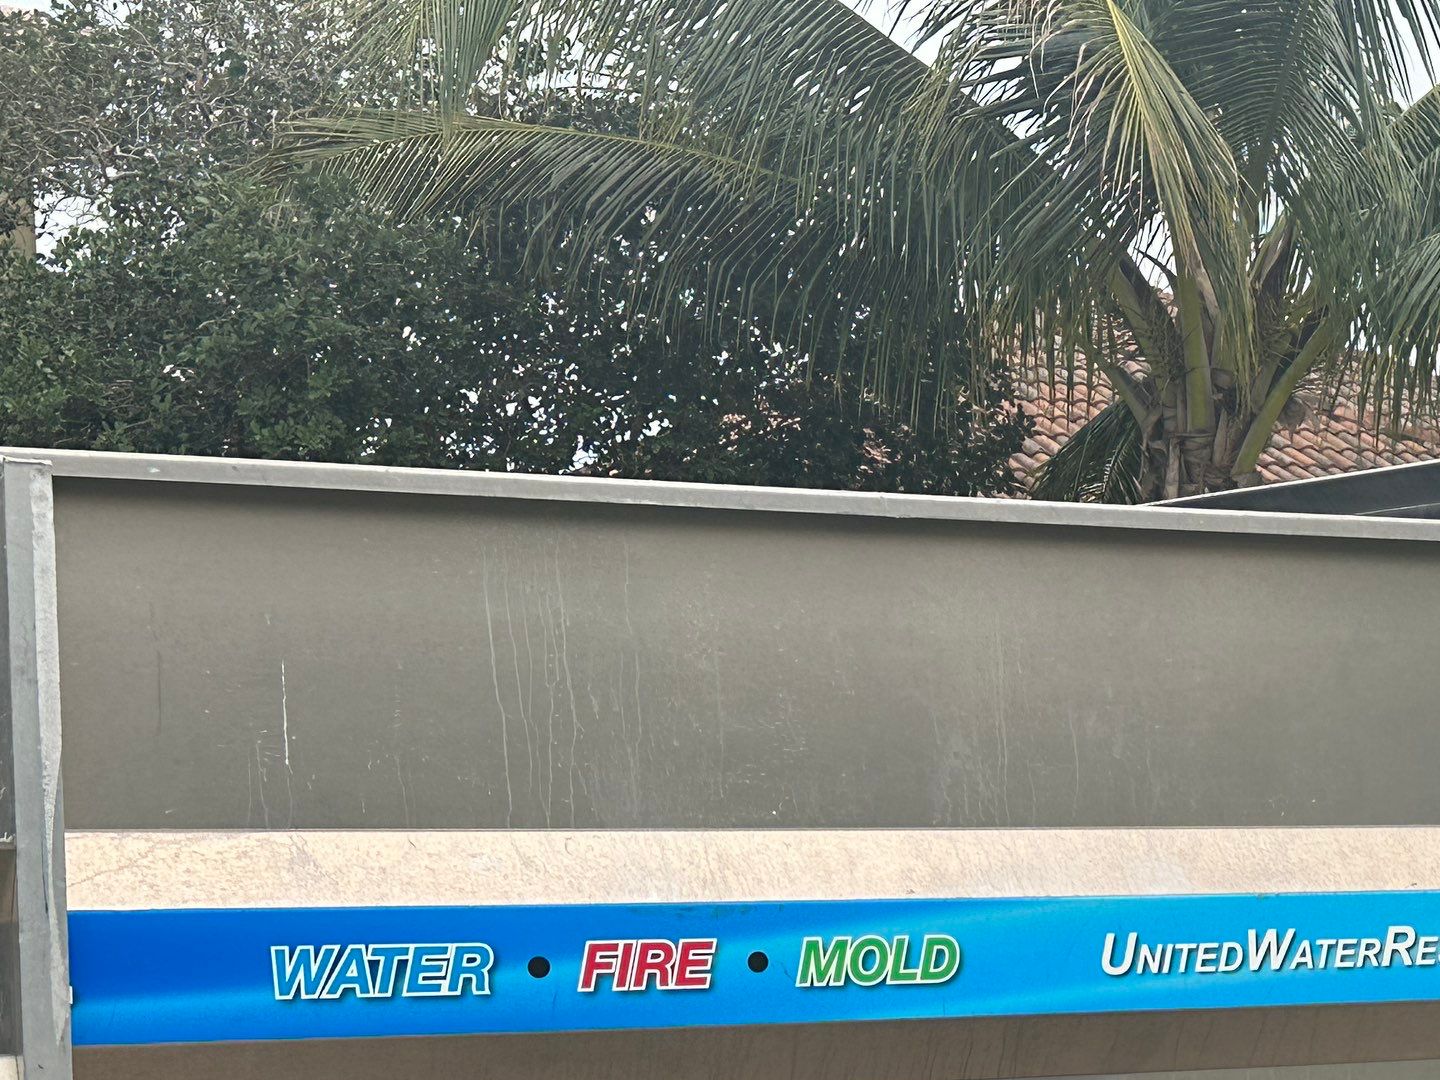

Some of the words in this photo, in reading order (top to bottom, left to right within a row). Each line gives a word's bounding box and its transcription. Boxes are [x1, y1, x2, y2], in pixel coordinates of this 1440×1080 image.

[270, 943, 495, 999] WATER
[577, 938, 718, 992] FIRE
[795, 934, 961, 987] MOLD
